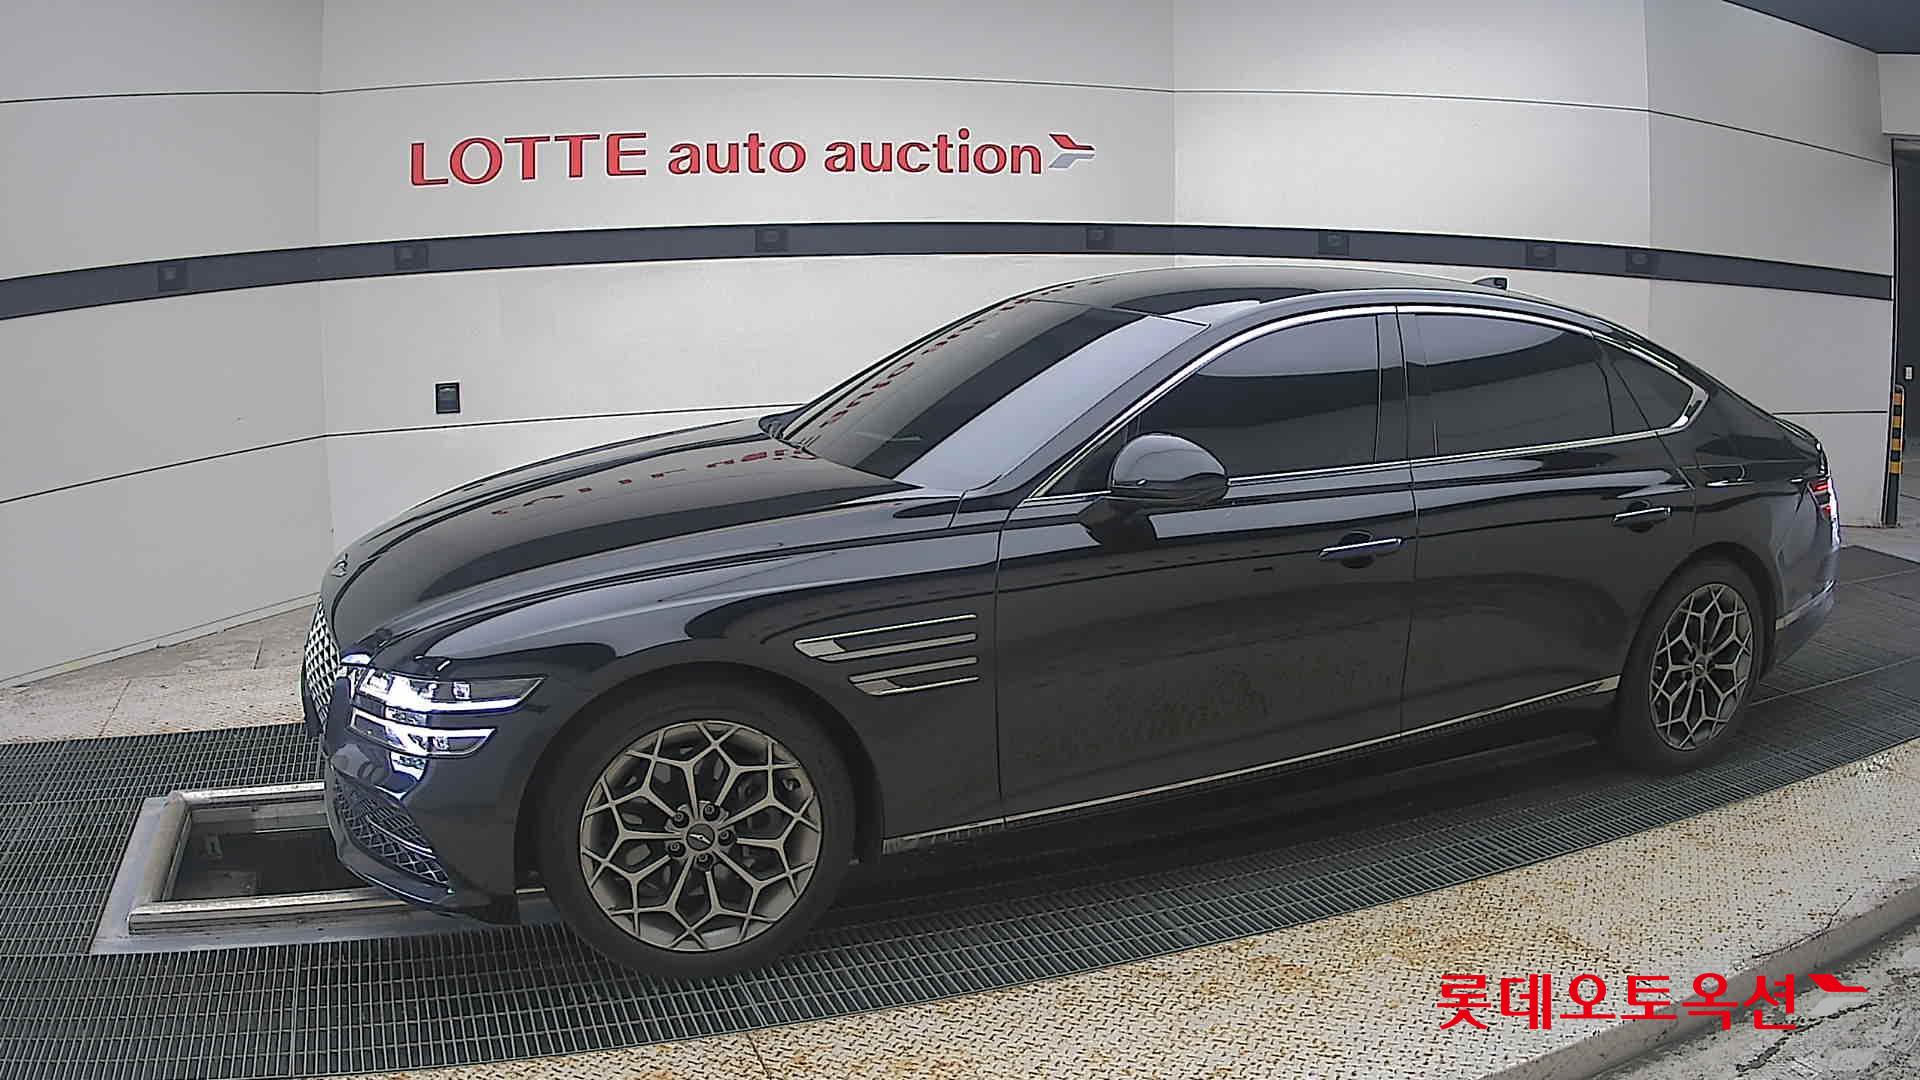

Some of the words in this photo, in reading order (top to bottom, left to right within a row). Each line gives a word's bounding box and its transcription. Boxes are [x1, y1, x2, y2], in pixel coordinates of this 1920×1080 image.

[410, 132, 647, 186] LOTTE
[667, 133, 807, 176] auto
[824, 127, 1043, 175] auction
